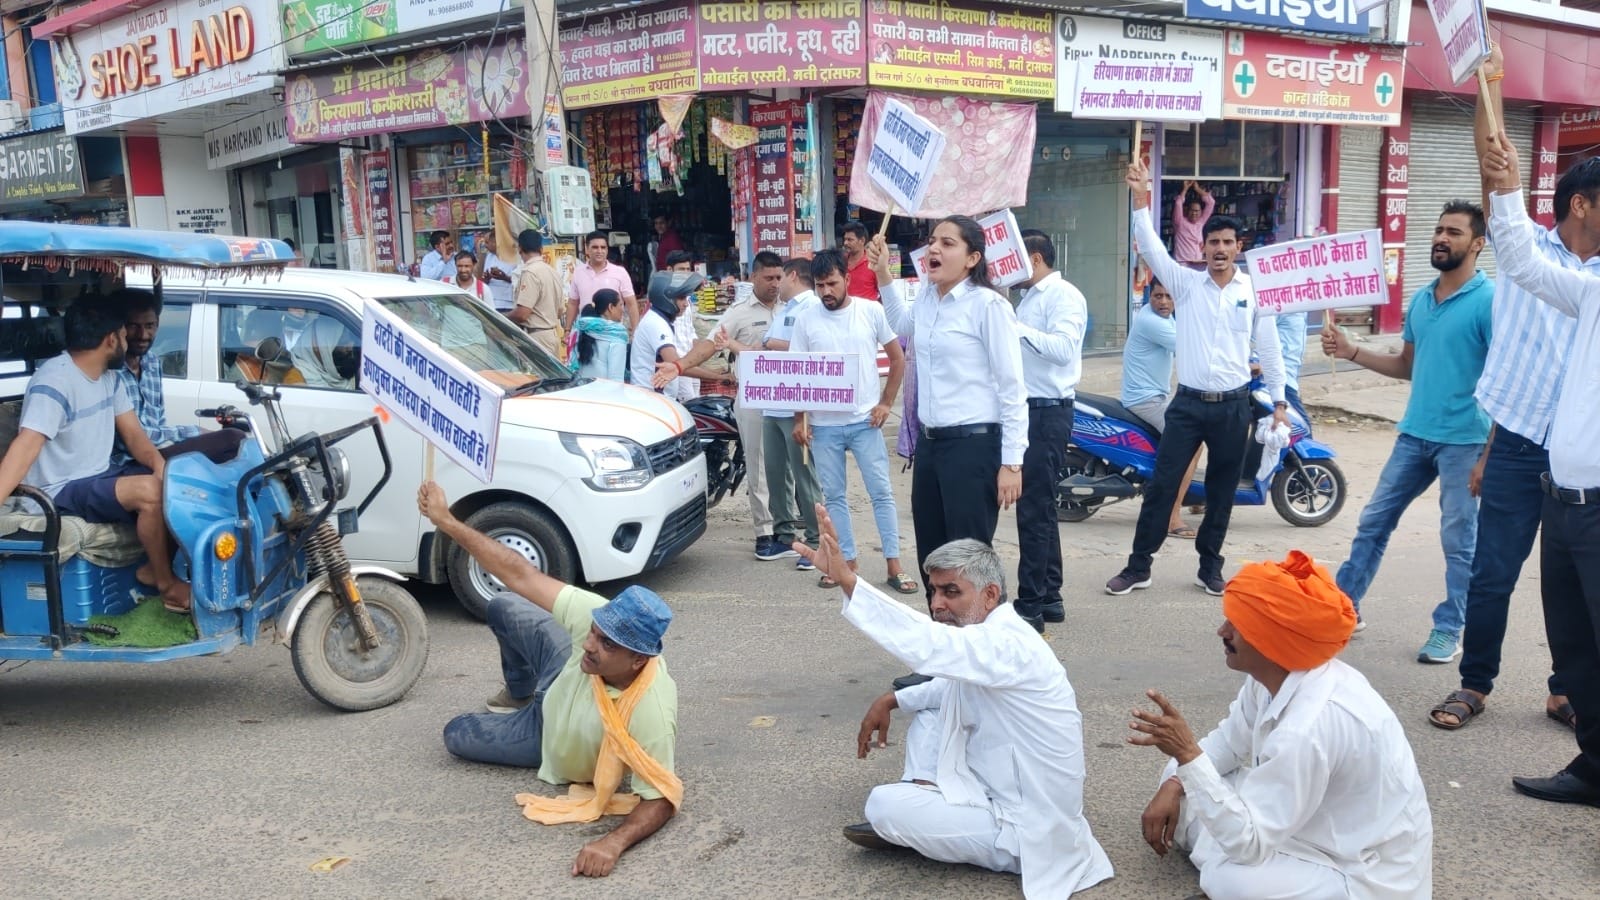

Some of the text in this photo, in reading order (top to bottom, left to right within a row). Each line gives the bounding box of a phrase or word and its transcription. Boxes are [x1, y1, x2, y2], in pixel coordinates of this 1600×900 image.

[616, 11, 637, 33] फेरों
[637, 13, 652, 27] का
[654, 6, 692, 25] सामान,
[764, 1, 792, 20] का
[796, 0, 862, 20] सामान
[905, 0, 937, 21] भवानी
[989, 10, 997, 26] &
[138, 14, 159, 33] MATA
[873, 18, 906, 40] पंसारी
[909, 28, 924, 42] का
[926, 25, 949, 44] सभी
[951, 32, 985, 48] सामान
[987, 31, 1019, 52] मिलता
[1127, 24, 1163, 40] OFFICE
[89, 5, 254, 98] SHOE LAND
[571, 46, 593, 63] हवन
[612, 40, 627, 54] का
[628, 32, 650, 51] सभी
[651, 29, 685, 48] सामान
[703, 20, 861, 62] मटर, पनीर, दूध, दही
[562, 66, 581, 84] चित
[582, 63, 594, 80] रेट
[594, 65, 608, 79] पर
[609, 58, 641, 77] मिलता
[897, 45, 931, 64] मोबाईल
[967, 53, 984, 67] सिम
[1008, 58, 1024, 72] मनी
[1265, 48, 1371, 87] दवाईयाँ
[357, 56, 406, 92] भवानी
[703, 67, 748, 85] मोबाईल
[793, 64, 817, 81] मनी
[820, 63, 862, 85] ट्रांसफर
[1094, 60, 1194, 83] हरियाणा सरकार होश में आओ
[365, 98, 371, 115] &
[1080, 87, 1203, 112] ईमानदार अधिकारी को वापस लगाओ
[752, 109, 787, 123] किरयाणा
[224, 126, 262, 155] HARICHAND
[1389, 137, 1409, 156] ठेका
[0, 143, 74, 180] GARMENTS
[1541, 147, 1557, 164] ठेका
[1388, 163, 1408, 183] देशी
[756, 213, 789, 225] का सामान
[1386, 198, 1407, 216] शराब
[1537, 198, 1554, 215] शराब
[1271, 247, 1297, 273] दादरी
[1296, 249, 1312, 268] का
[1313, 242, 1328, 266] DC
[1330, 239, 1354, 264] कैसा
[1355, 234, 1368, 260] हो
[1256, 285, 1294, 312] उपायुक्त
[1322, 274, 1343, 298] कौर
[1343, 272, 1366, 297] जैसा
[1367, 268, 1380, 293] हो
[374, 320, 482, 419] दादरी की जनता न्याय चाहती है
[754, 355, 845, 377] हरियाणा सरकार होश में आओ
[744, 380, 854, 404] ईमानदार अधिकारी को वापस लगाओ
[363, 354, 391, 397] उपायुक्त
[391, 376, 420, 416] महोदया
[420, 396, 431, 426] को
[431, 407, 452, 443] वापस
[453, 422, 477, 462] चाहती
